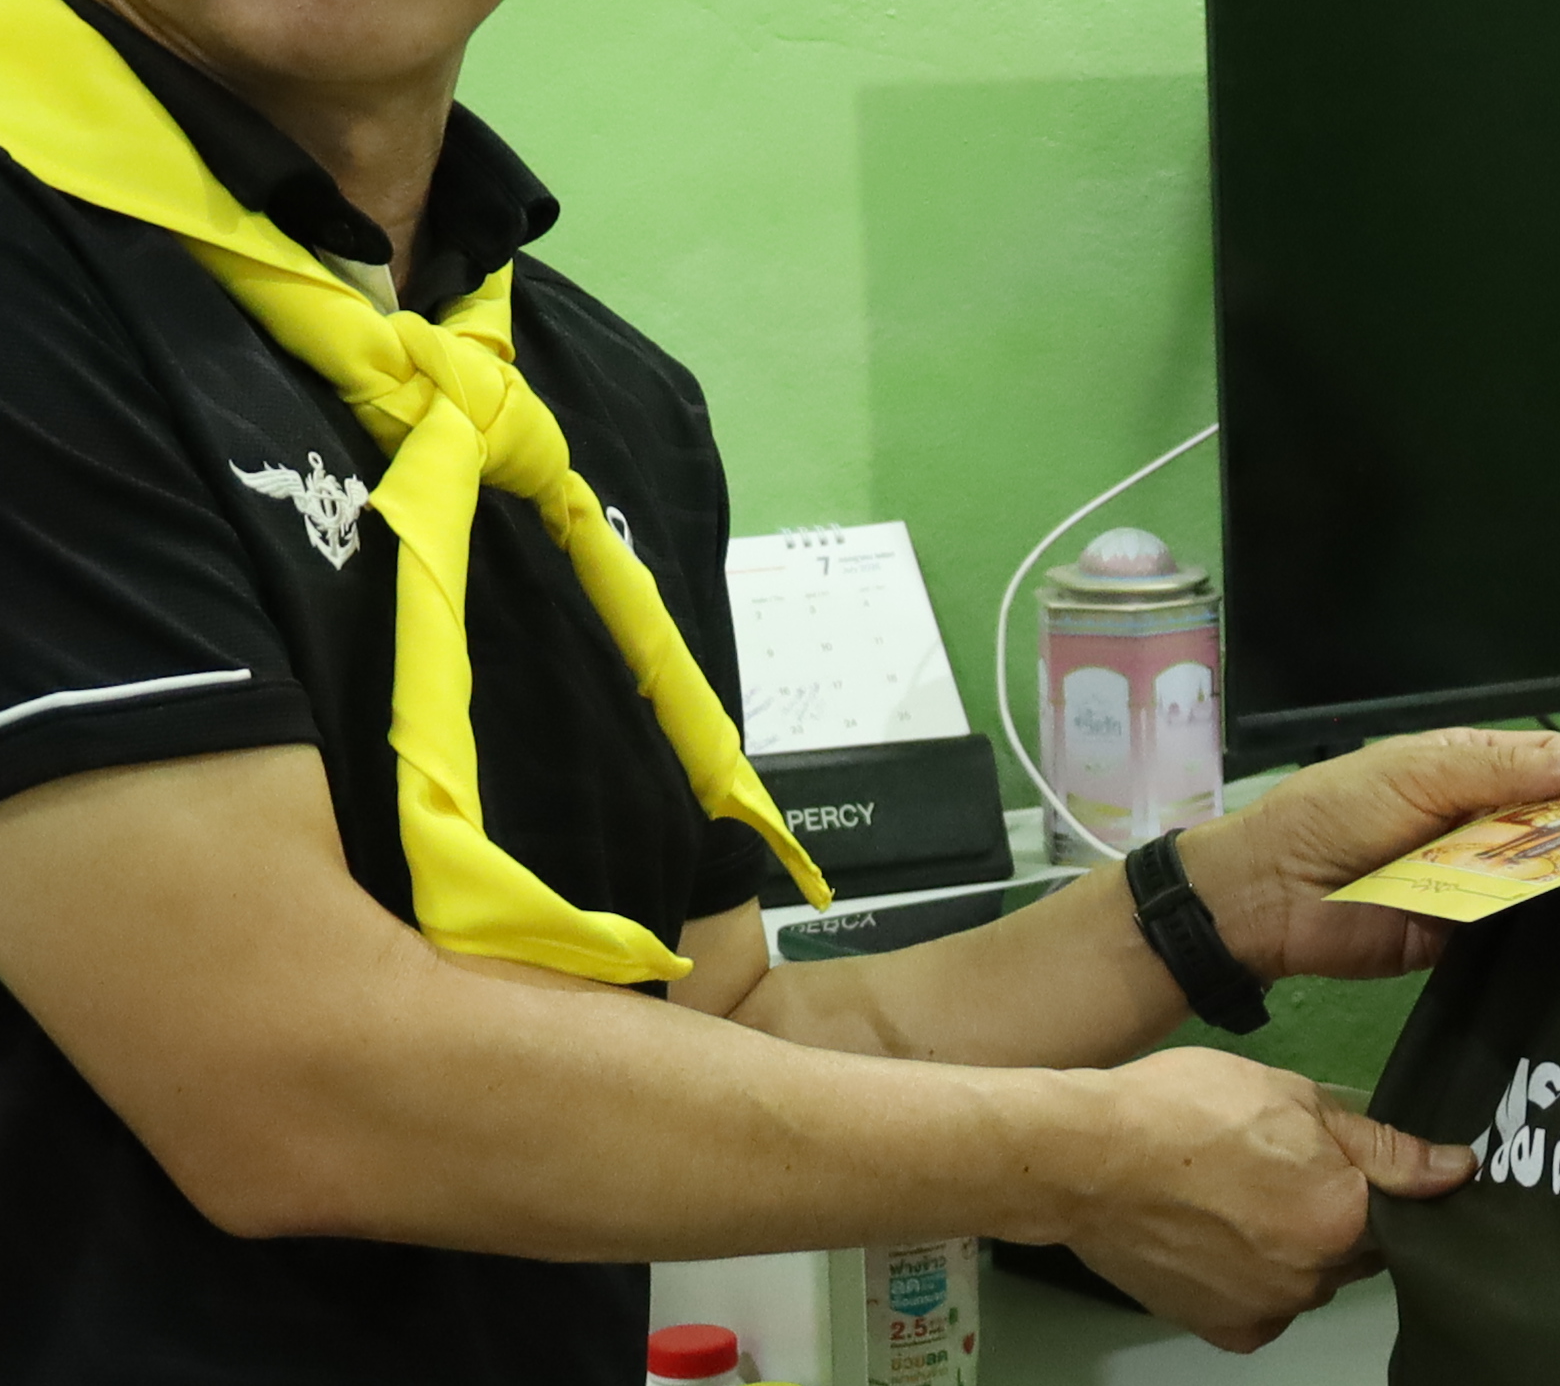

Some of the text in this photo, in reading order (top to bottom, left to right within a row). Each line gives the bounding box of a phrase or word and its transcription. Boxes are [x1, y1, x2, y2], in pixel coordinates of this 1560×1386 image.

[817, 556, 829, 575] 7
[820, 642, 833, 652] 10
[873, 636, 884, 645] 11
[832, 680, 843, 690] 17
[786, 802, 875, 832] PERCY
[890, 1318, 927, 1340] 2.5
